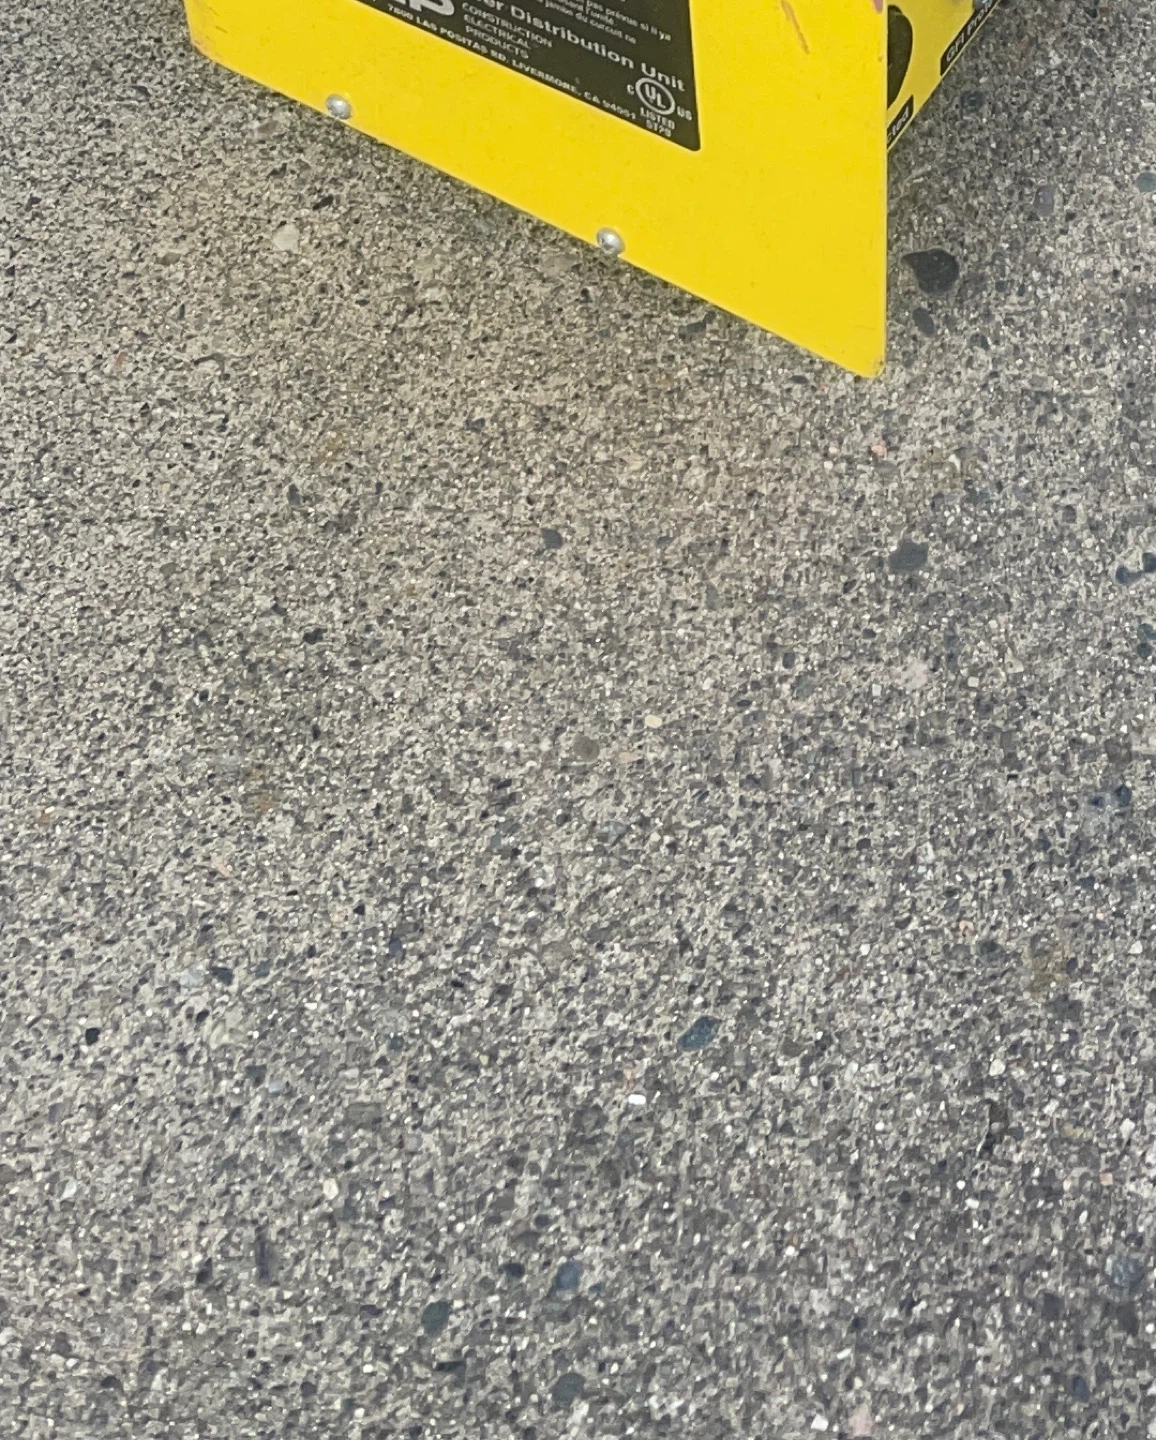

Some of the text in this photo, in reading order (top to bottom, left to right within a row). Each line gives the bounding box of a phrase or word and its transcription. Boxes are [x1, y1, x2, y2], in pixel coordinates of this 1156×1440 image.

[462, 2, 551, 47] CONSTRUCTION
[463, 14, 530, 48] ELECTRICAL
[465, 25, 528, 58] PRODUCTS
[415, 16, 437, 31] LAS
[439, 27, 487, 53] POSITAS
[583, 91, 600, 103] CA
[510, 5, 633, 68] Distribution
[641, 62, 684, 91] Unit
[946, 34, 965, 62] GFI
[639, 107, 674, 129] LISTED
